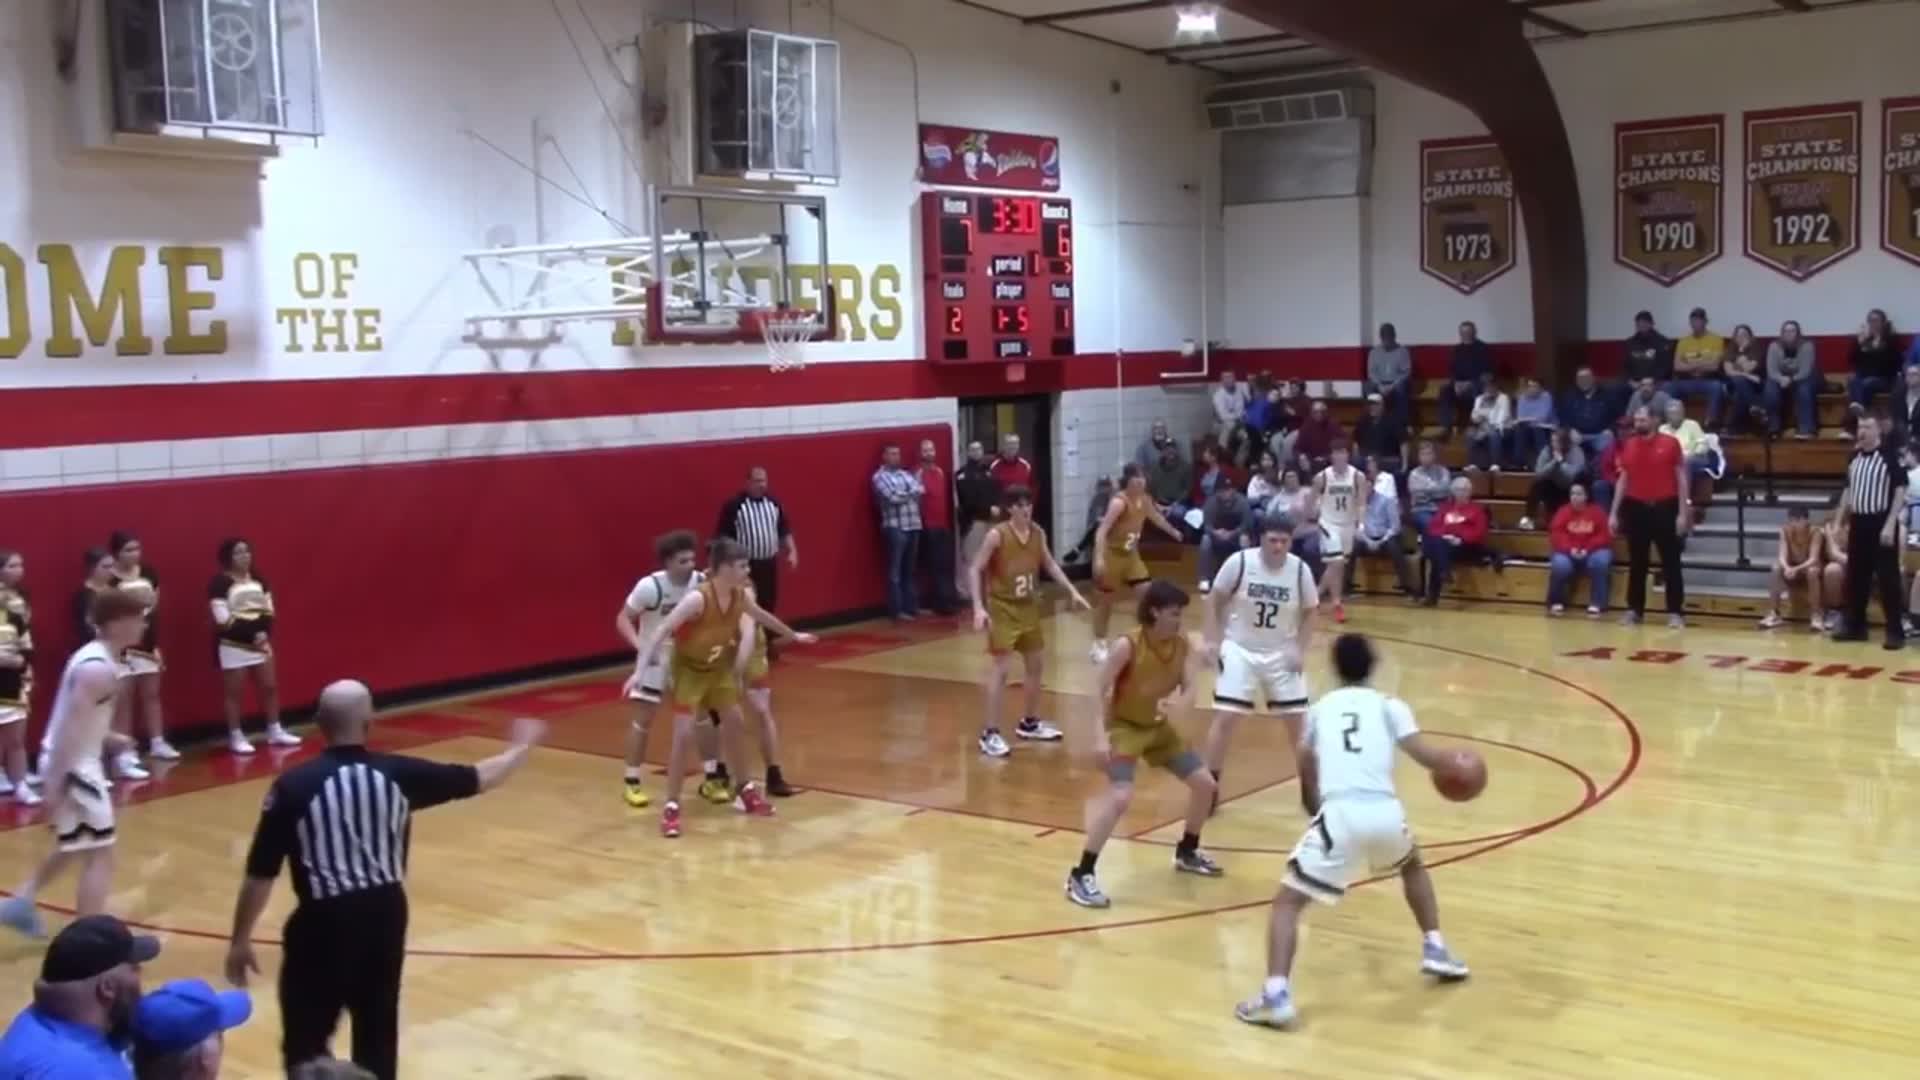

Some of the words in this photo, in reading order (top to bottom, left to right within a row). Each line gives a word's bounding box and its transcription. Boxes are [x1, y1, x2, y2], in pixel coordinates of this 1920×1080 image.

[1631, 151, 1705, 168] STATE
[1762, 139, 1842, 157] STATE
[1433, 167, 1501, 183] STATE
[1617, 166, 1721, 189] CHAMPIONS
[1746, 155, 1858, 181] CHAMPIONS
[1423, 179, 1513, 203] CHAMPIONS
[1058, 224, 1070, 257] 6
[1643, 221, 1696, 251] 1990
[1773, 213, 1831, 245] 1992
[1445, 234, 1491, 261] 1973
[293, 252, 359, 298] OF
[276, 308, 382, 352] THE
[951, 307, 962, 333] 2
[1253, 601, 1279, 629] 32
[1341, 711, 1362, 753] 2
